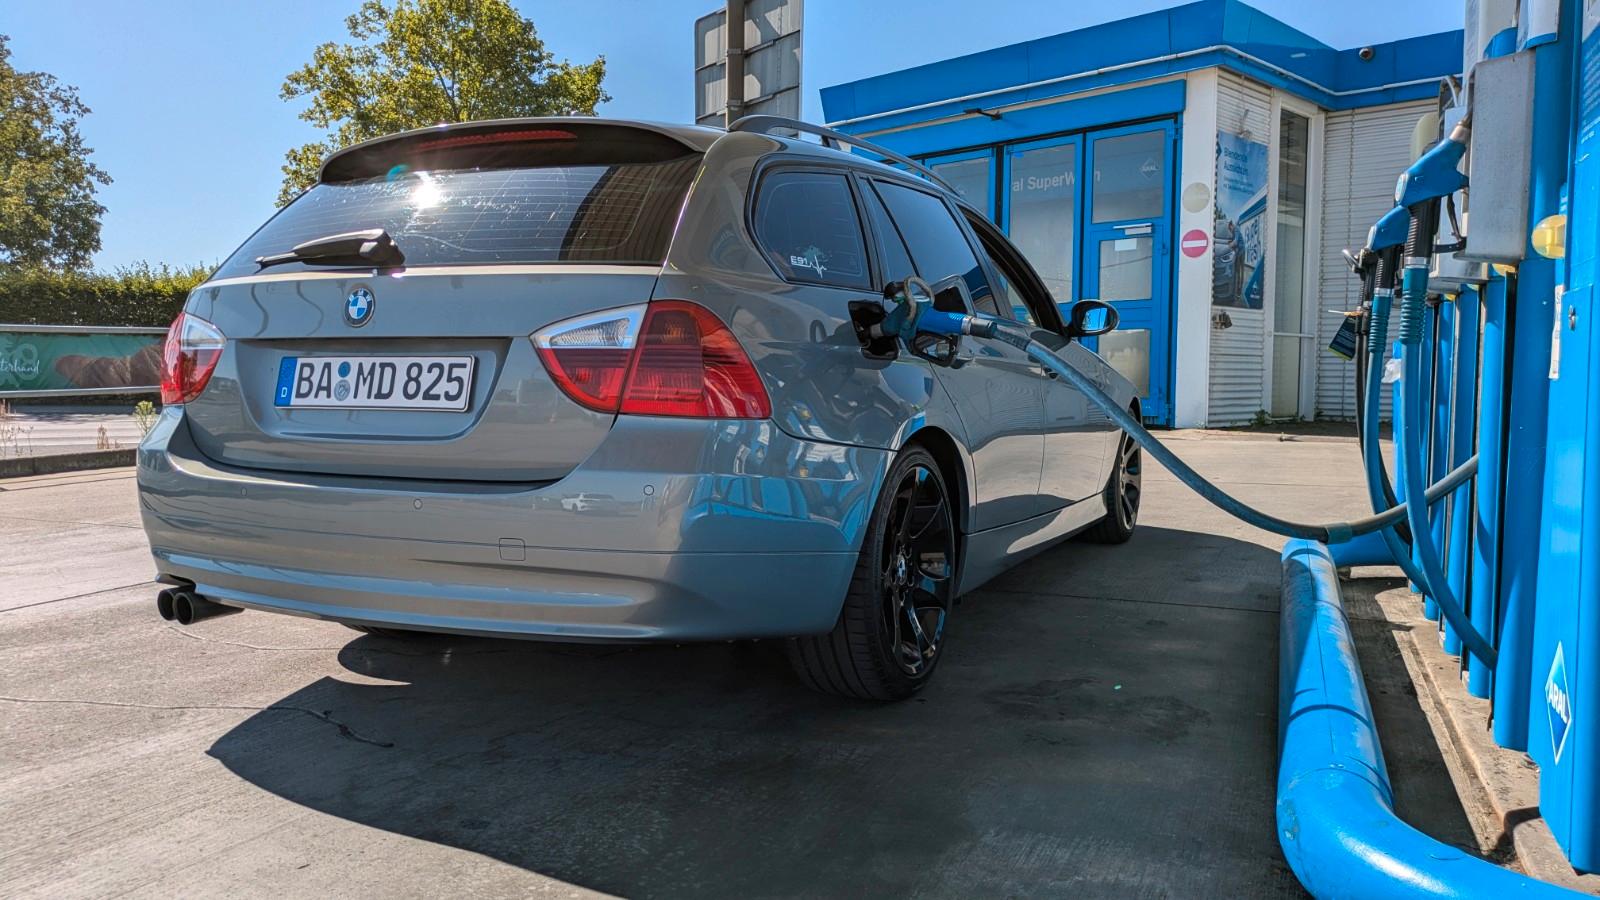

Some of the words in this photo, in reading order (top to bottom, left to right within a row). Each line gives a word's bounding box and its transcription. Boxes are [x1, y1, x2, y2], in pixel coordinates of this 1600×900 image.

[790, 255, 808, 265] E91
[0, 358, 40, 374] terhand
[295, 362, 332, 399] BA
[353, 362, 397, 400] MD
[402, 362, 468, 401] 825
[280, 386, 288, 398] D
[1548, 680, 1568, 724] ARAL
